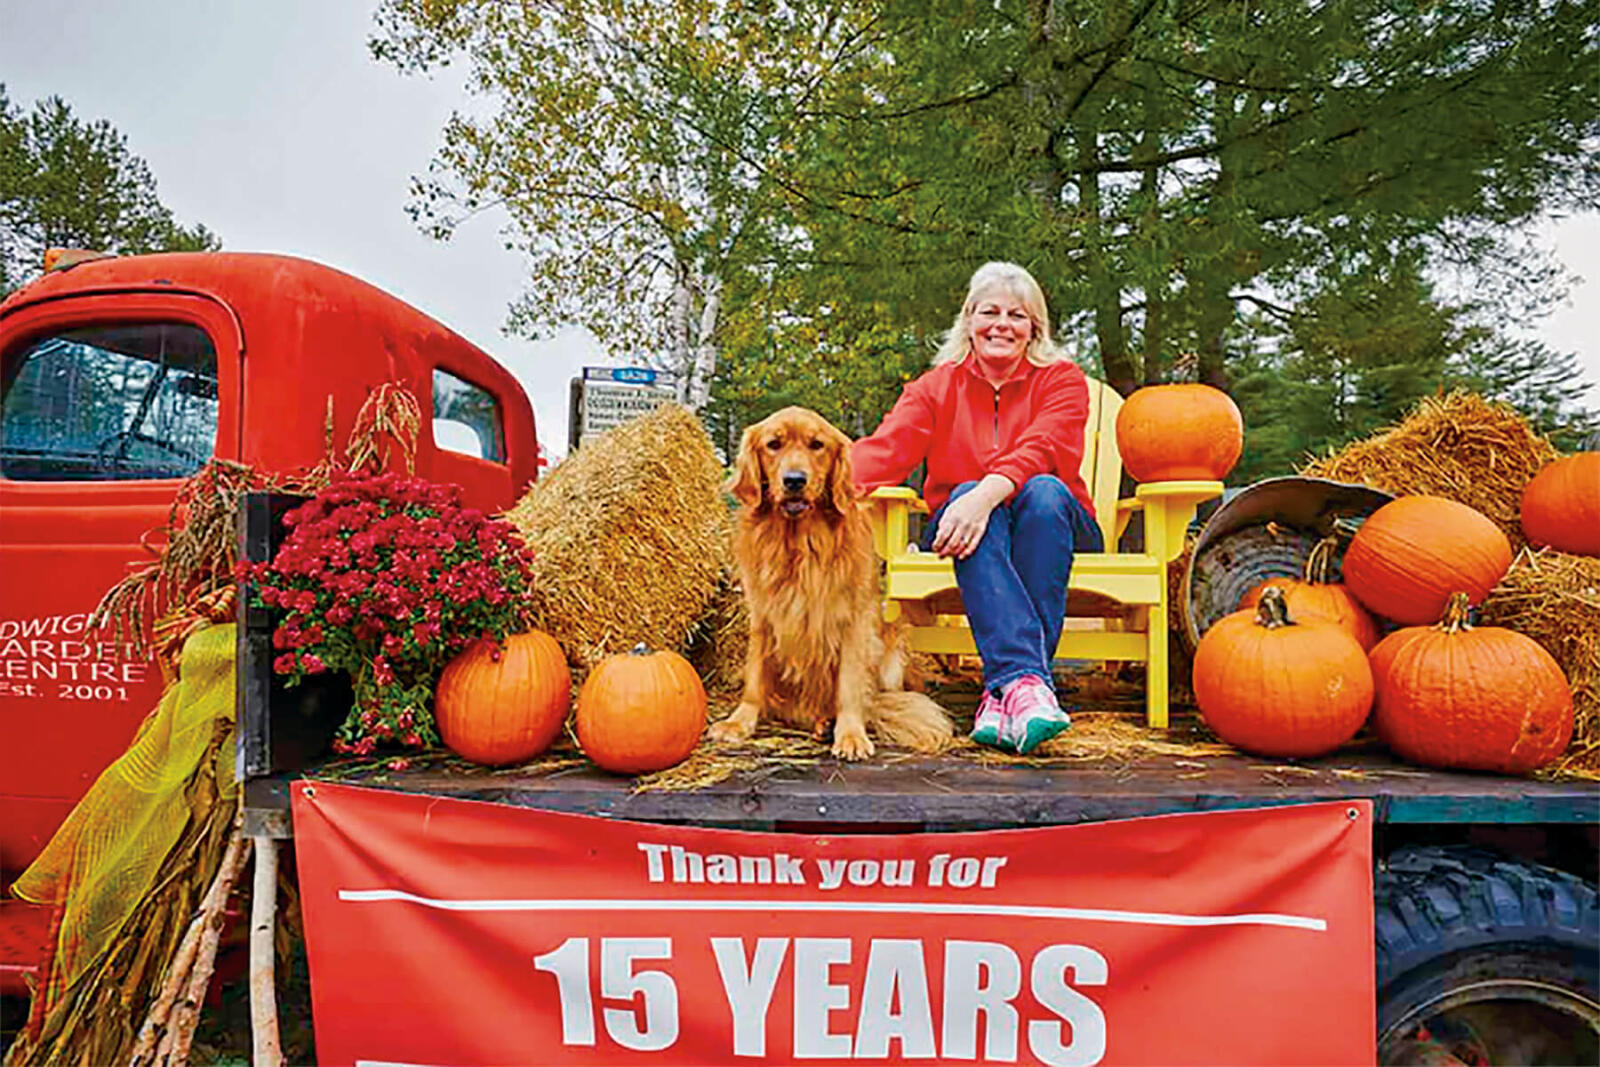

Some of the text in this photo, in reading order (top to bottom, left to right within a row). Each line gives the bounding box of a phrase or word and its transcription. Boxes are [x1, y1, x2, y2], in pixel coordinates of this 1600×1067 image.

[0, 611, 110, 640] DWIGH
[0, 659, 145, 683] ENTRE
[58, 684, 129, 702] 2001
[637, 842, 1008, 891] Thank you for
[533, 936, 1109, 1067] 15 YEARS
